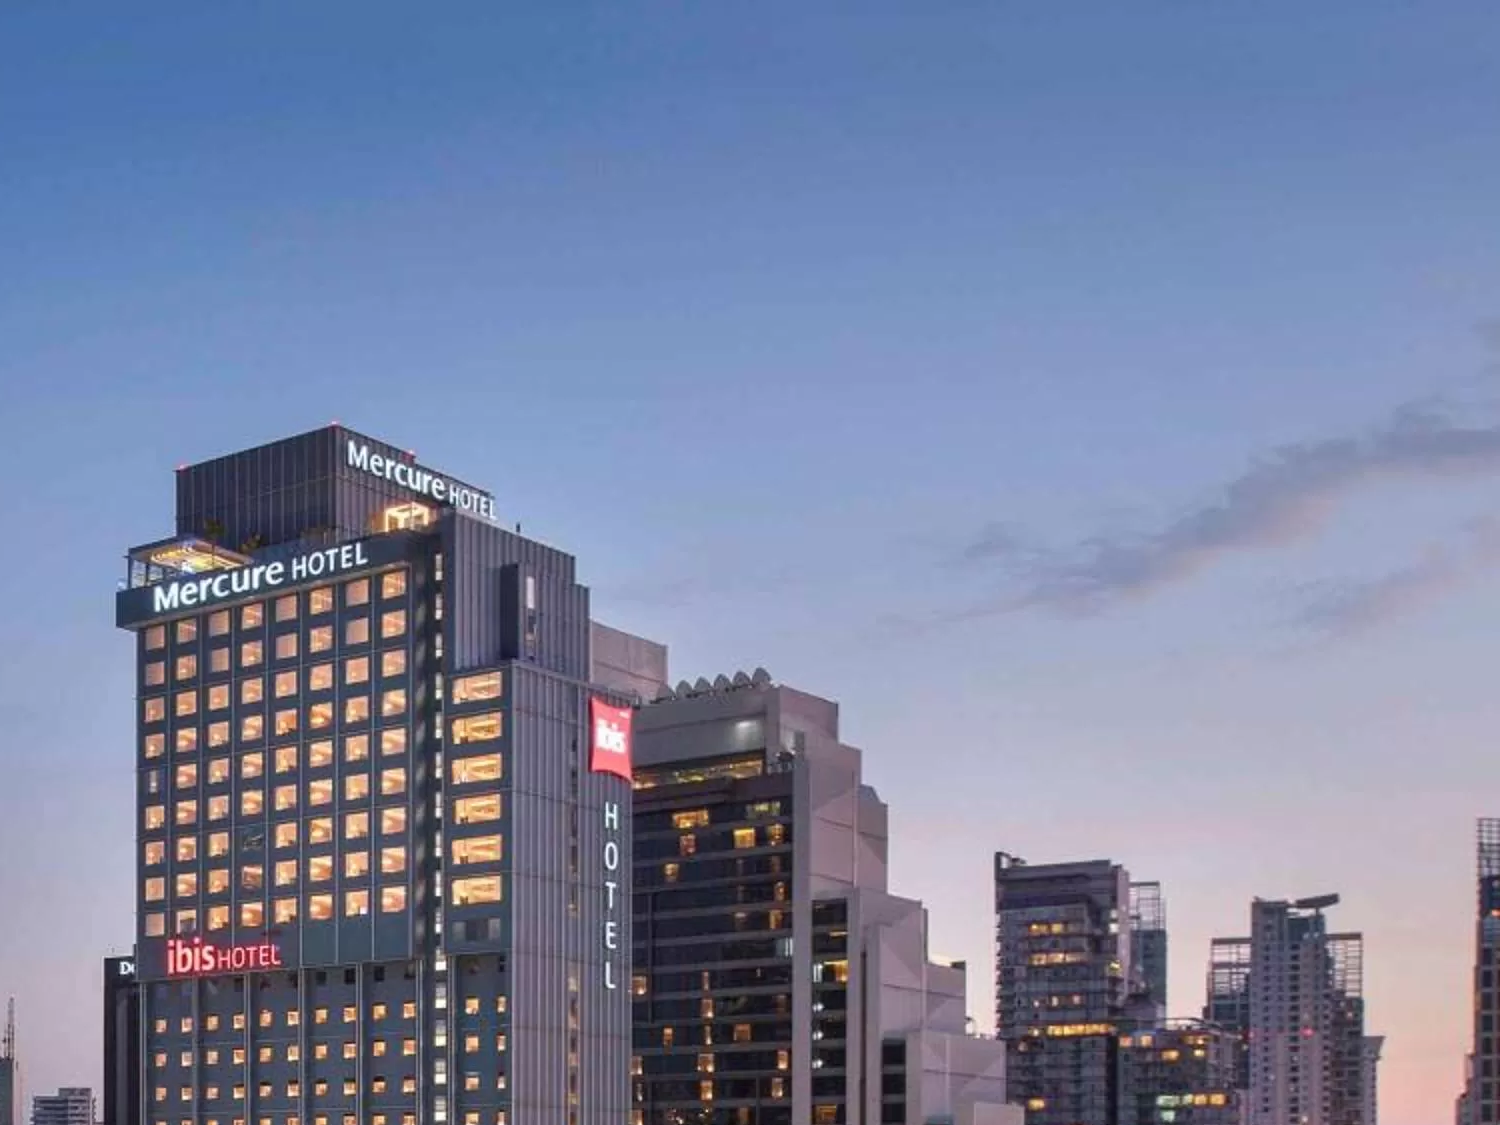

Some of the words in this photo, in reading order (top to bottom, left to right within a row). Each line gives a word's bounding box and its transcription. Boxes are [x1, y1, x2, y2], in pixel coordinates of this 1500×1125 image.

[347, 440, 445, 500] Mercure
[449, 484, 497, 520] HOTEL
[153, 559, 284, 612] Mercure
[292, 543, 367, 581] HOTEL
[605, 801, 618, 989] HOTEL
[167, 937, 215, 974] ibis
[217, 945, 281, 970] HOTEL
